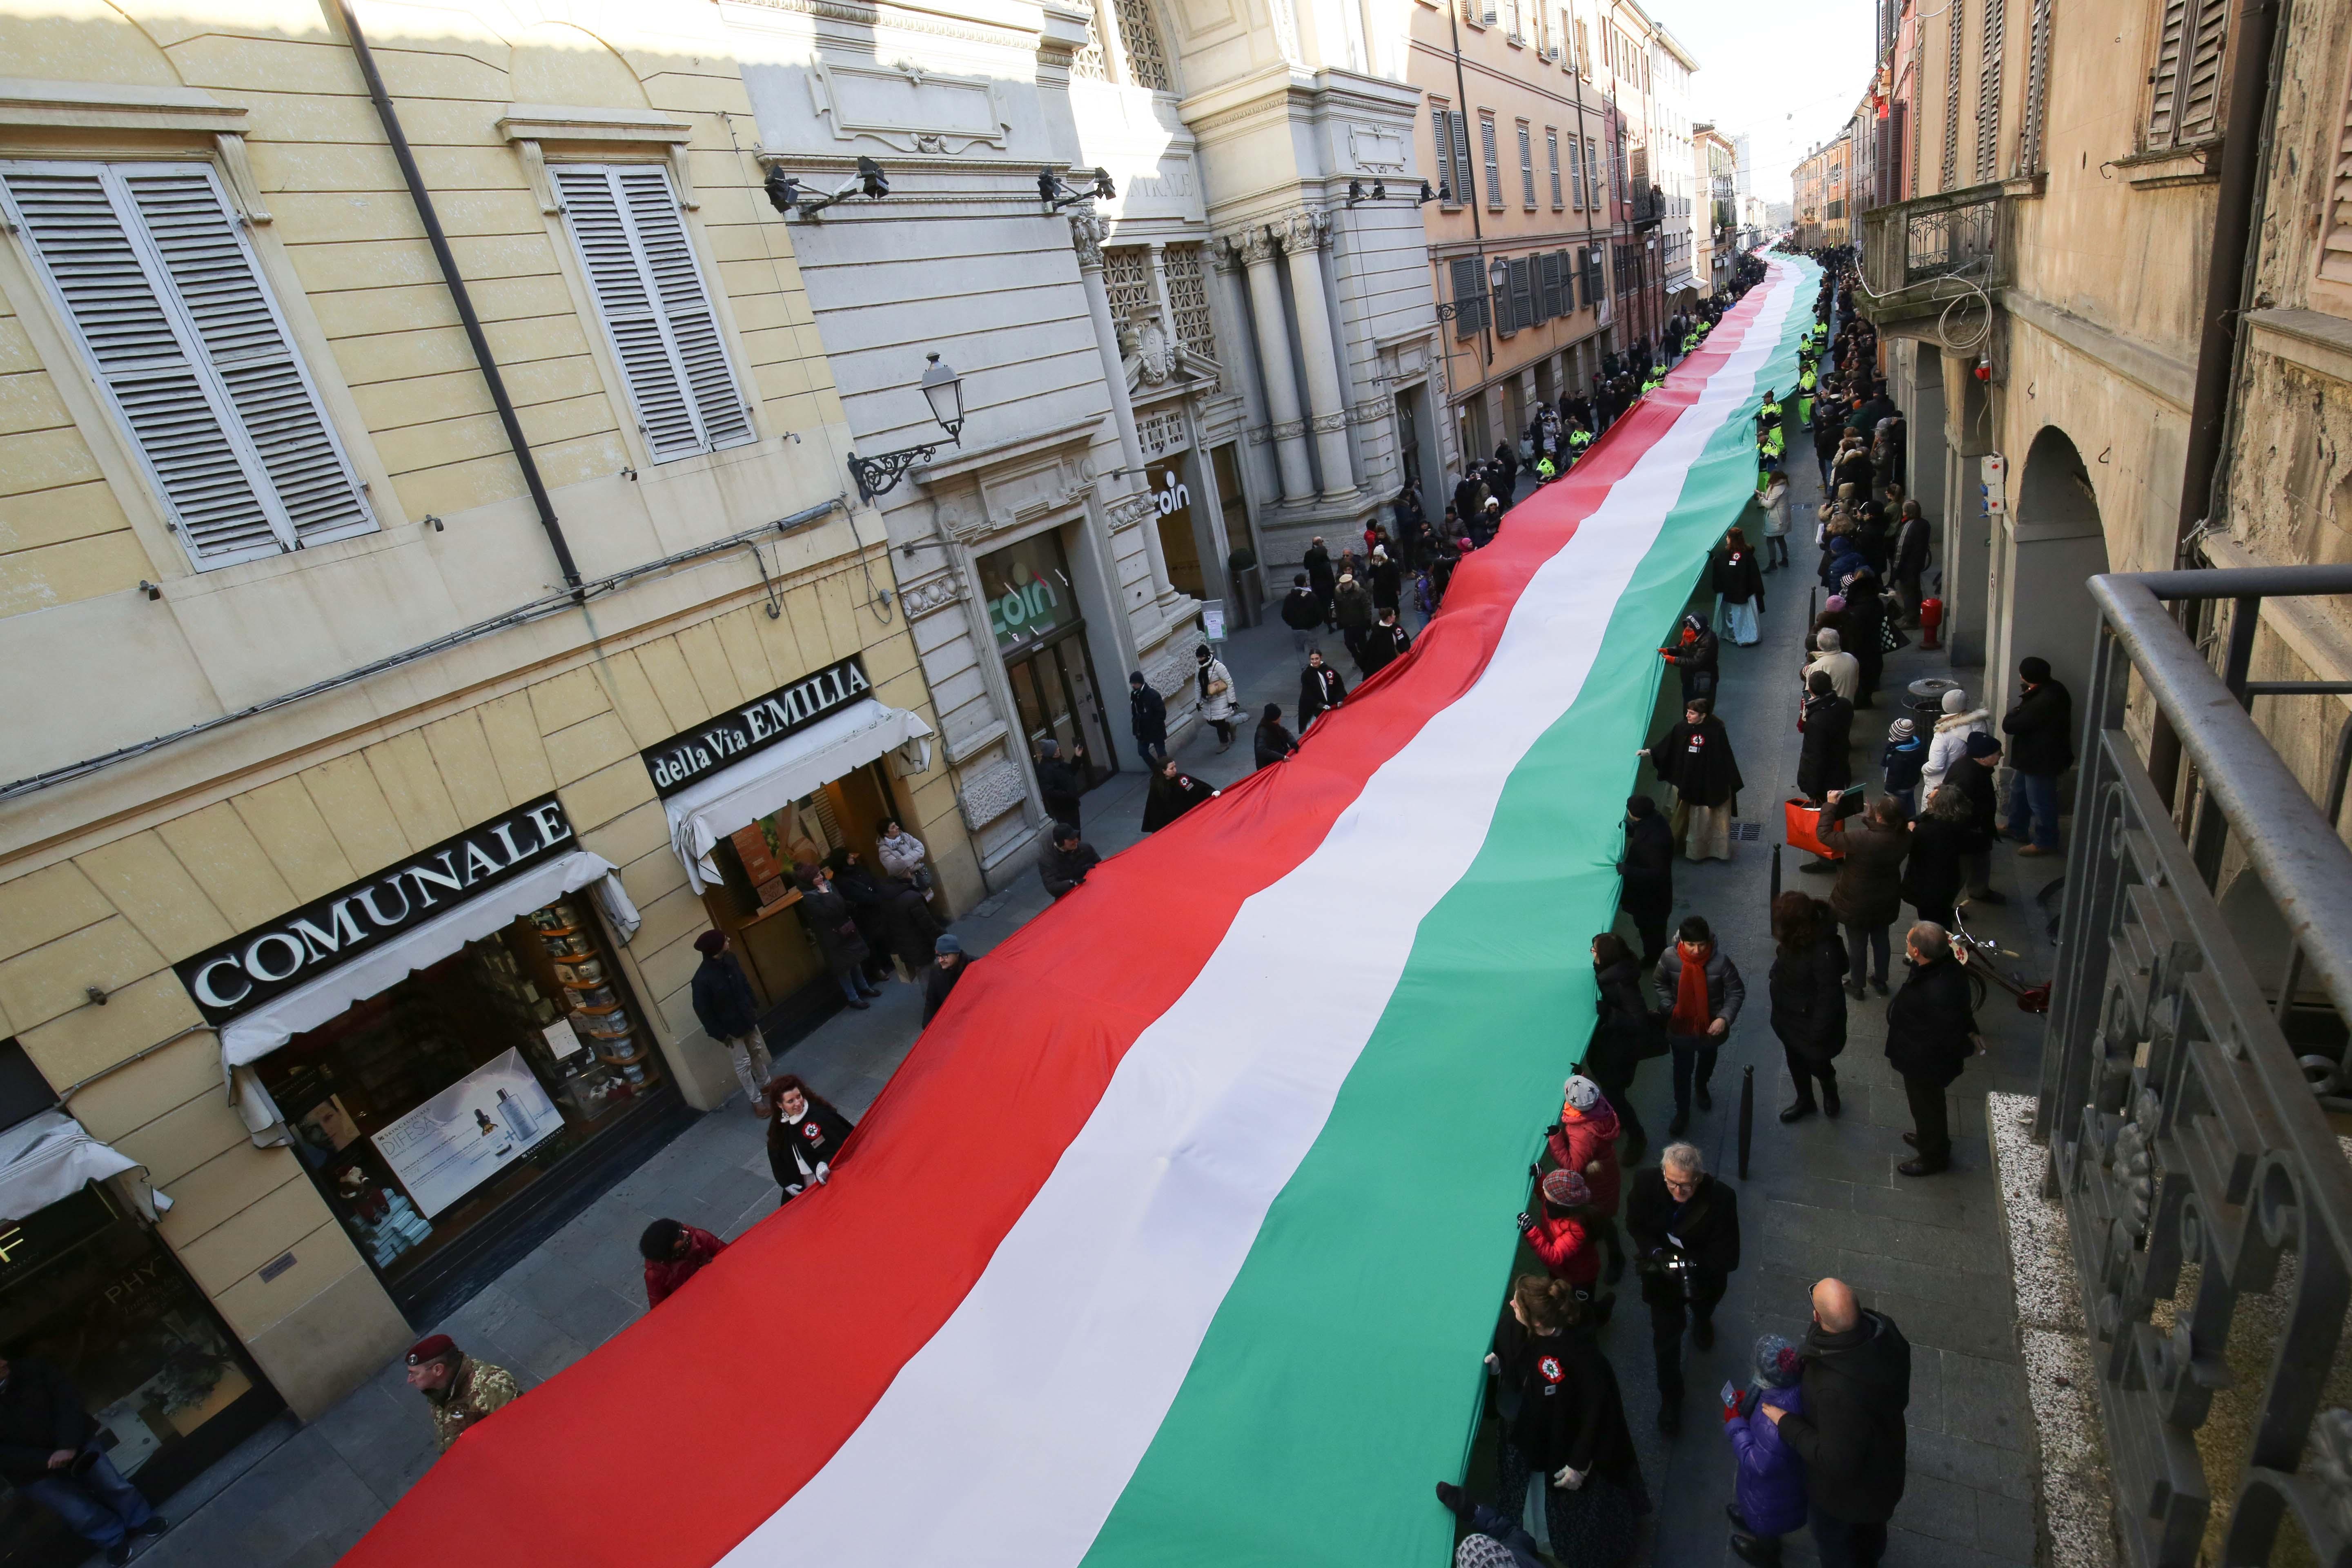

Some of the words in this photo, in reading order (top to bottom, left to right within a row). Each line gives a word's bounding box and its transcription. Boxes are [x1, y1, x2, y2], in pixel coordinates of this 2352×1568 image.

[655, 746, 712, 788] della
[704, 728, 746, 760] Via
[741, 662, 870, 744] EMILIA
[193, 800, 572, 1009] COMUNALE
[382, 1116, 437, 1156] DIFESA
[385, 1107, 431, 1138] SKINCEUTICALS
[526, 1127, 565, 1155] SKINCEUTICALS
